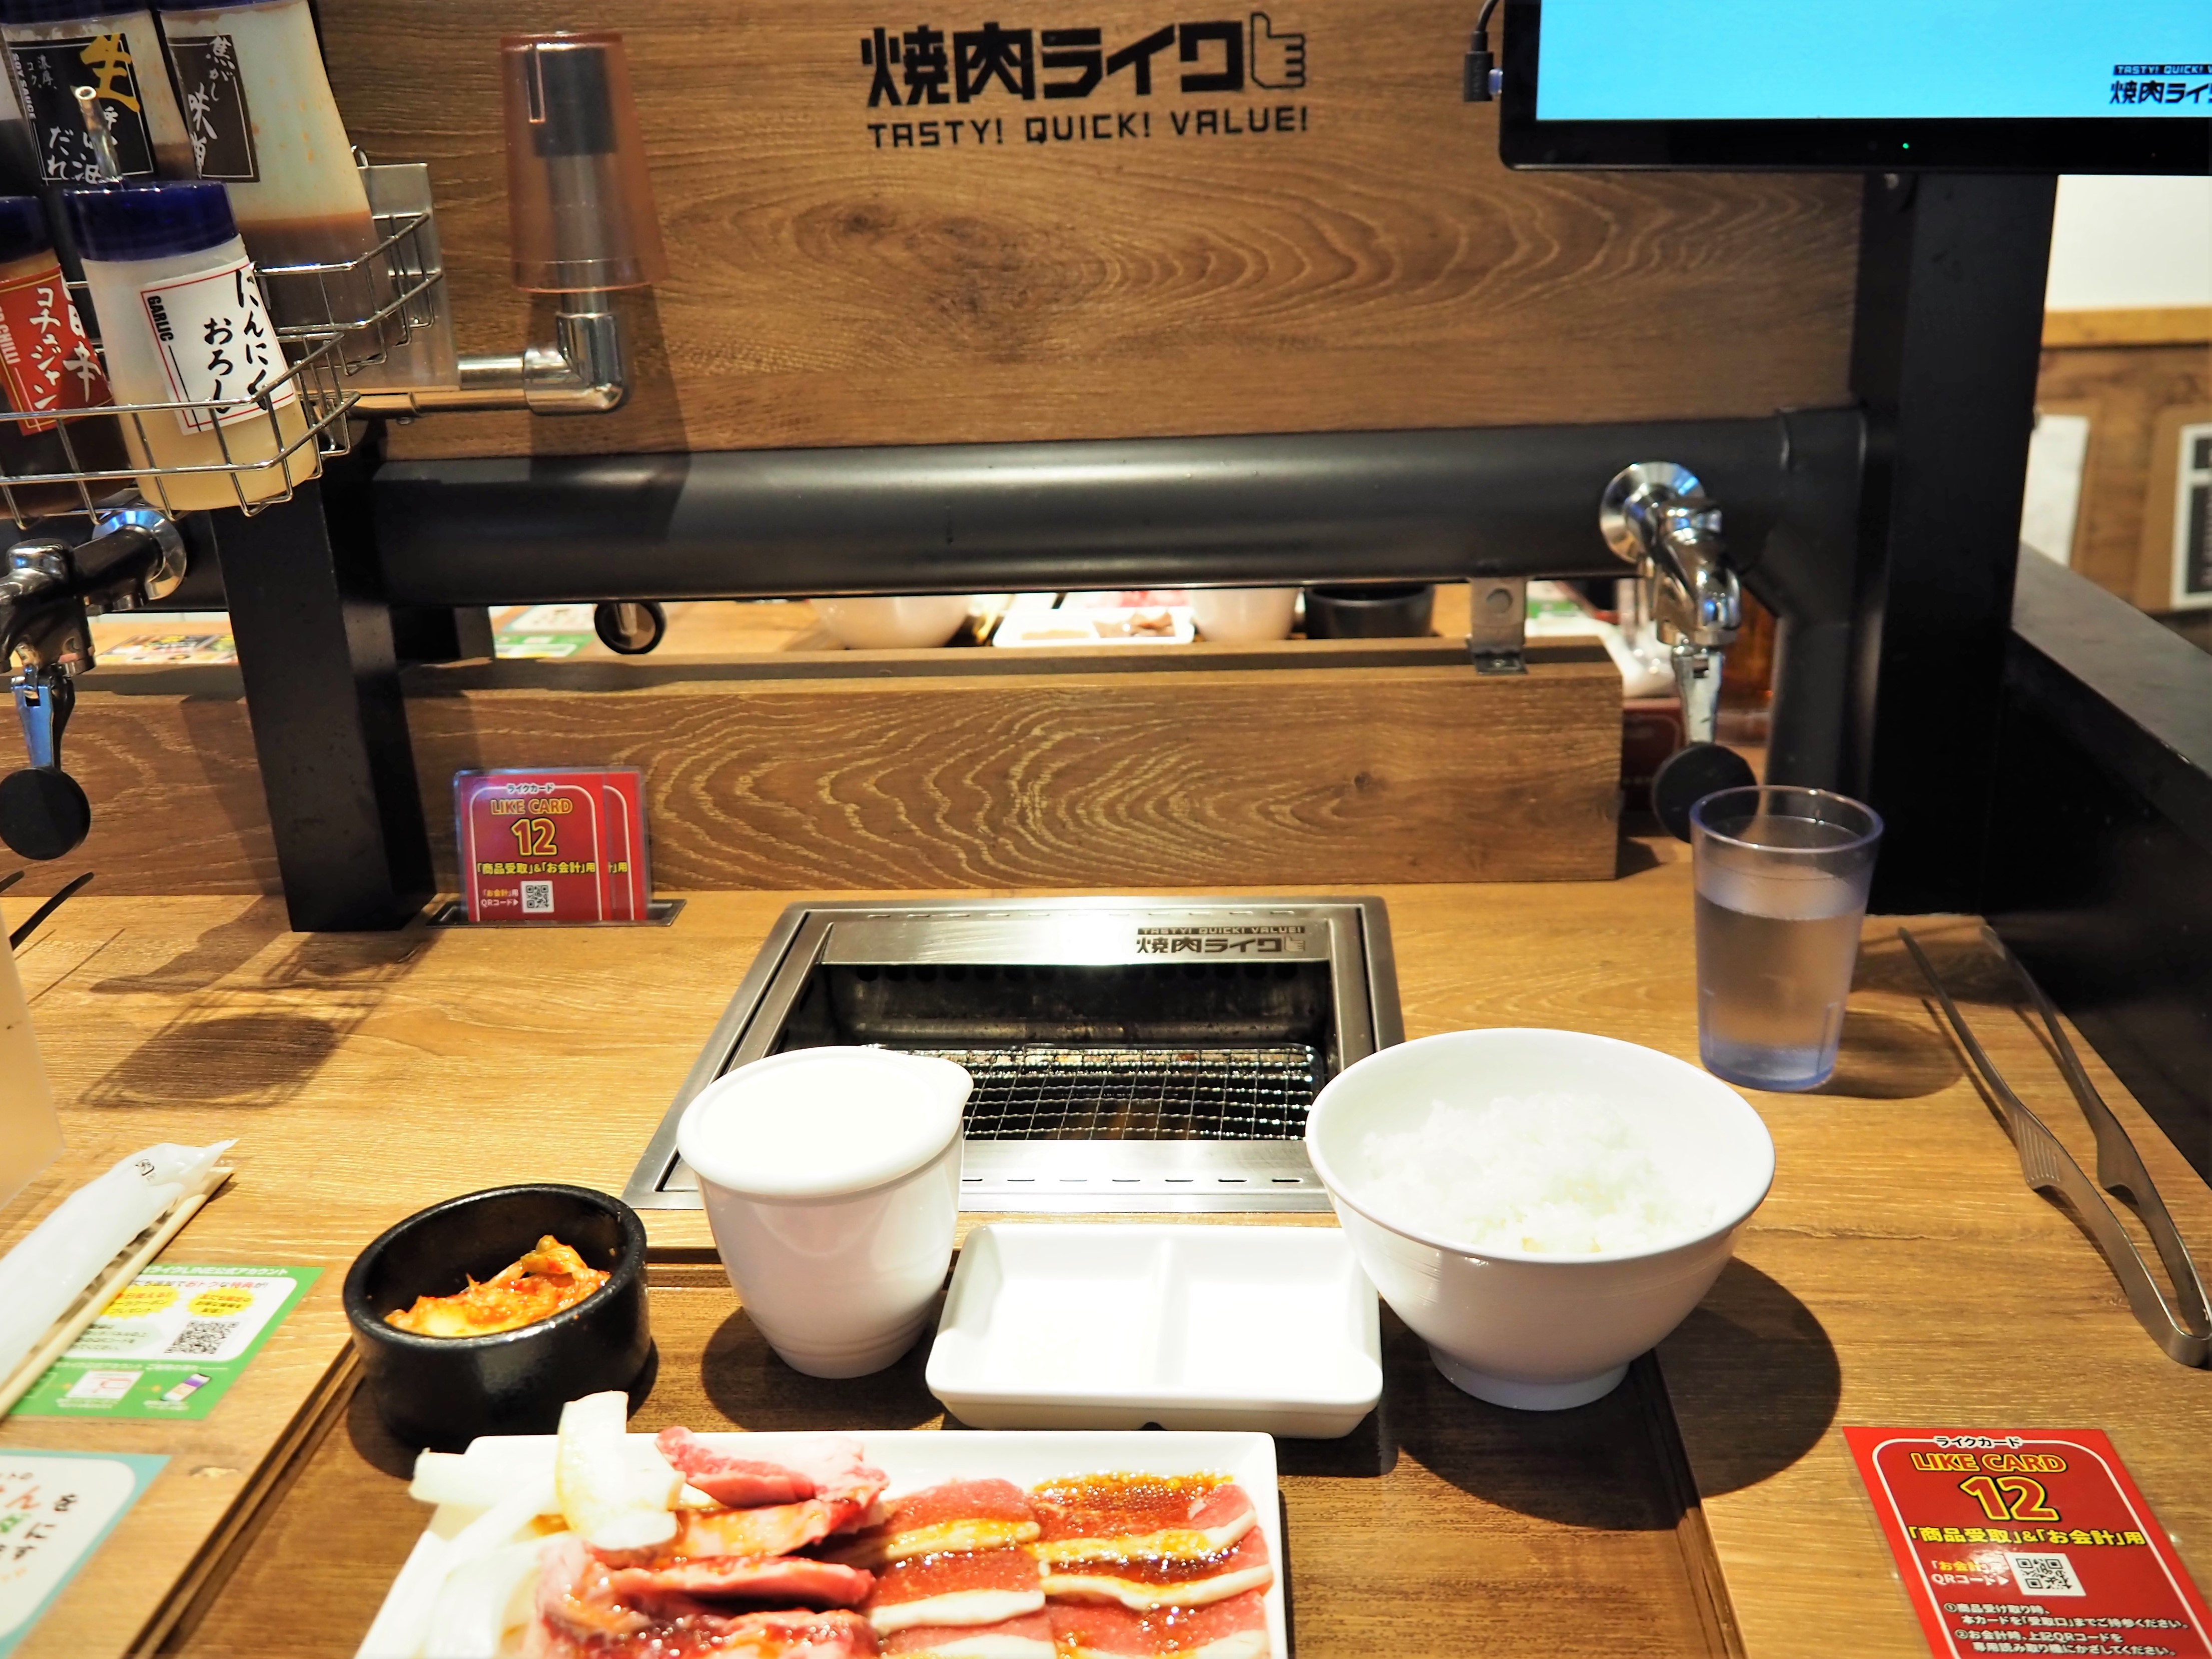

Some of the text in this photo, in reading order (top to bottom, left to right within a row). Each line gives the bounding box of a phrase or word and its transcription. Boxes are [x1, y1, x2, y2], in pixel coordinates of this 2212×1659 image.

[205, 36, 236, 102] 焦がし
[860, 22, 1244, 108] 焼肉ライク
[2117, 65, 2159, 75] TASTY!
[2163, 65, 2202, 75] QUICK!
[2109, 80, 2212, 104] 焼肉ライ
[868, 106, 1307, 148] TASTY! QUICK! VALUE!
[48, 126, 74, 180] だれ
[147, 295, 174, 342] GARLIC
[29, 287, 62, 410] コチュジャン
[235, 268, 269, 411] にんにく
[203, 318, 234, 414] おろし
[490, 798, 573, 815] LIKE CARD
[506, 783, 554, 793] ライクカード
[510, 817, 558, 856] 12
[1136, 936, 1283, 953] 焼肉ライク
[1934, 1435, 2021, 1448] ライクカード
[1909, 1452, 2069, 1473] LIKE CARD
[1959, 1476, 2061, 1522] 12
[1907, 1526, 2146, 1546] 「商品受取」&「お会計」用
[1931, 1573, 1996, 1585] QRコード
